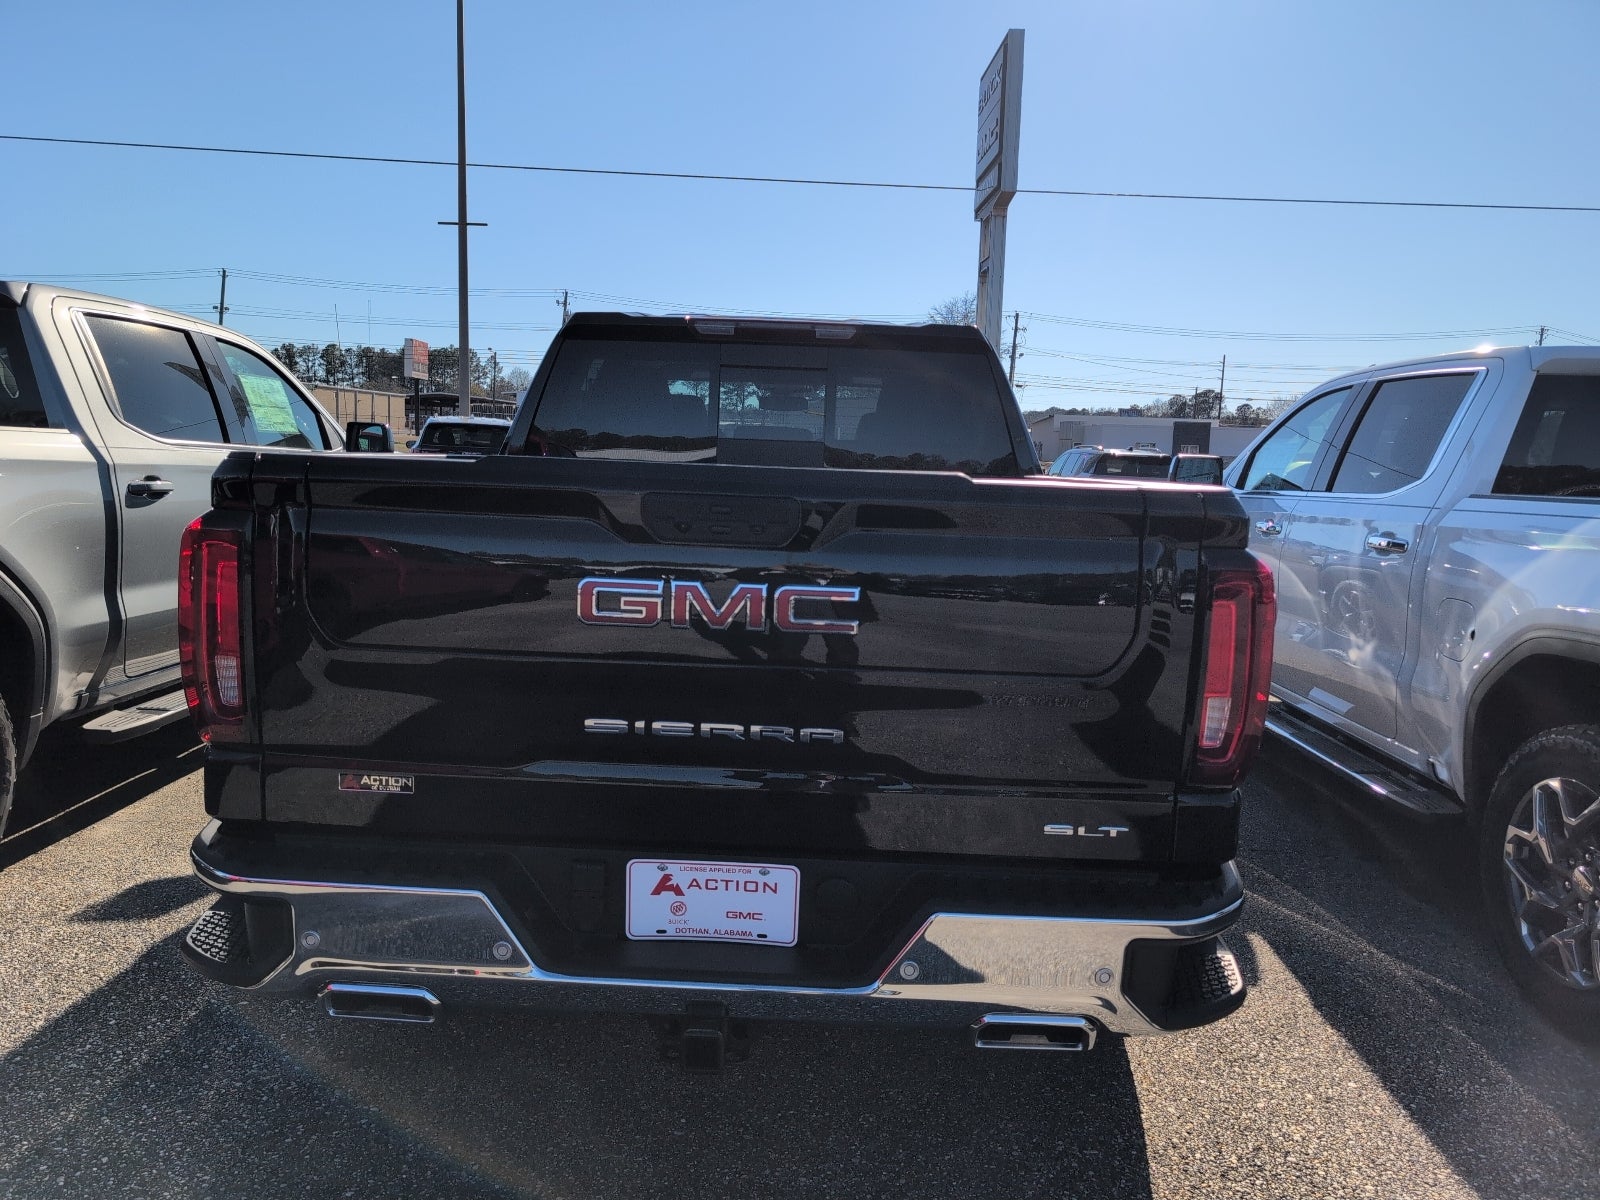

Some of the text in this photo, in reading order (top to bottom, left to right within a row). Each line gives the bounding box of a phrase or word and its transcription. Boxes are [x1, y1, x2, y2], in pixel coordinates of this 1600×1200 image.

[576, 576, 861, 635] GMC
[584, 717, 845, 745] SIERRA
[360, 775, 412, 787] ACTION
[1043, 823, 1130, 838] SLT
[679, 865, 708, 873] LICENSE
[708, 867, 737, 875] APPLIED
[686, 878, 778, 895] ACTION
[725, 910, 764, 921] GMC
[675, 927, 754, 938] DOTHAN, ALABAMA
